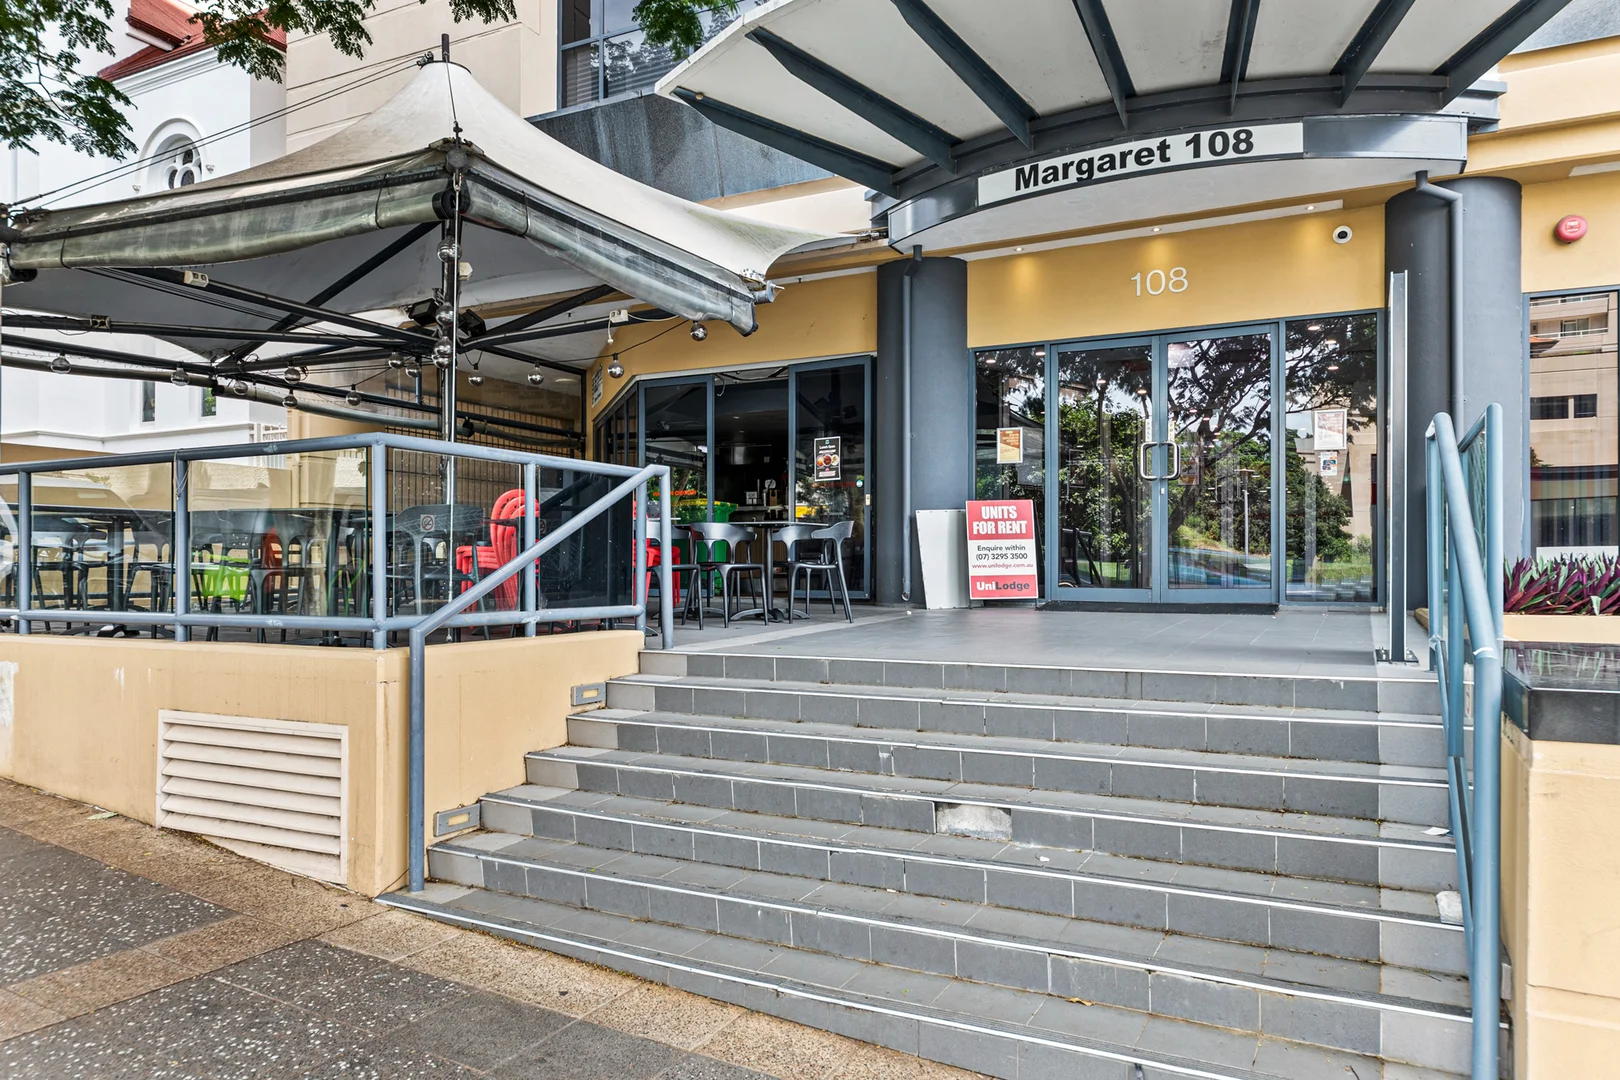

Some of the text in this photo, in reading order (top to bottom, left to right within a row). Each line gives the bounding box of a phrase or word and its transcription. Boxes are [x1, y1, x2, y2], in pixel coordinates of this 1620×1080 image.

[1015, 128, 1254, 192] Margaret 108
[1130, 266, 1189, 297] 108
[981, 505, 1017, 519] UNITS
[973, 521, 1028, 534] FOR RENT
[976, 553, 989, 561] (07)
[976, 581, 1030, 591] UniLodge
